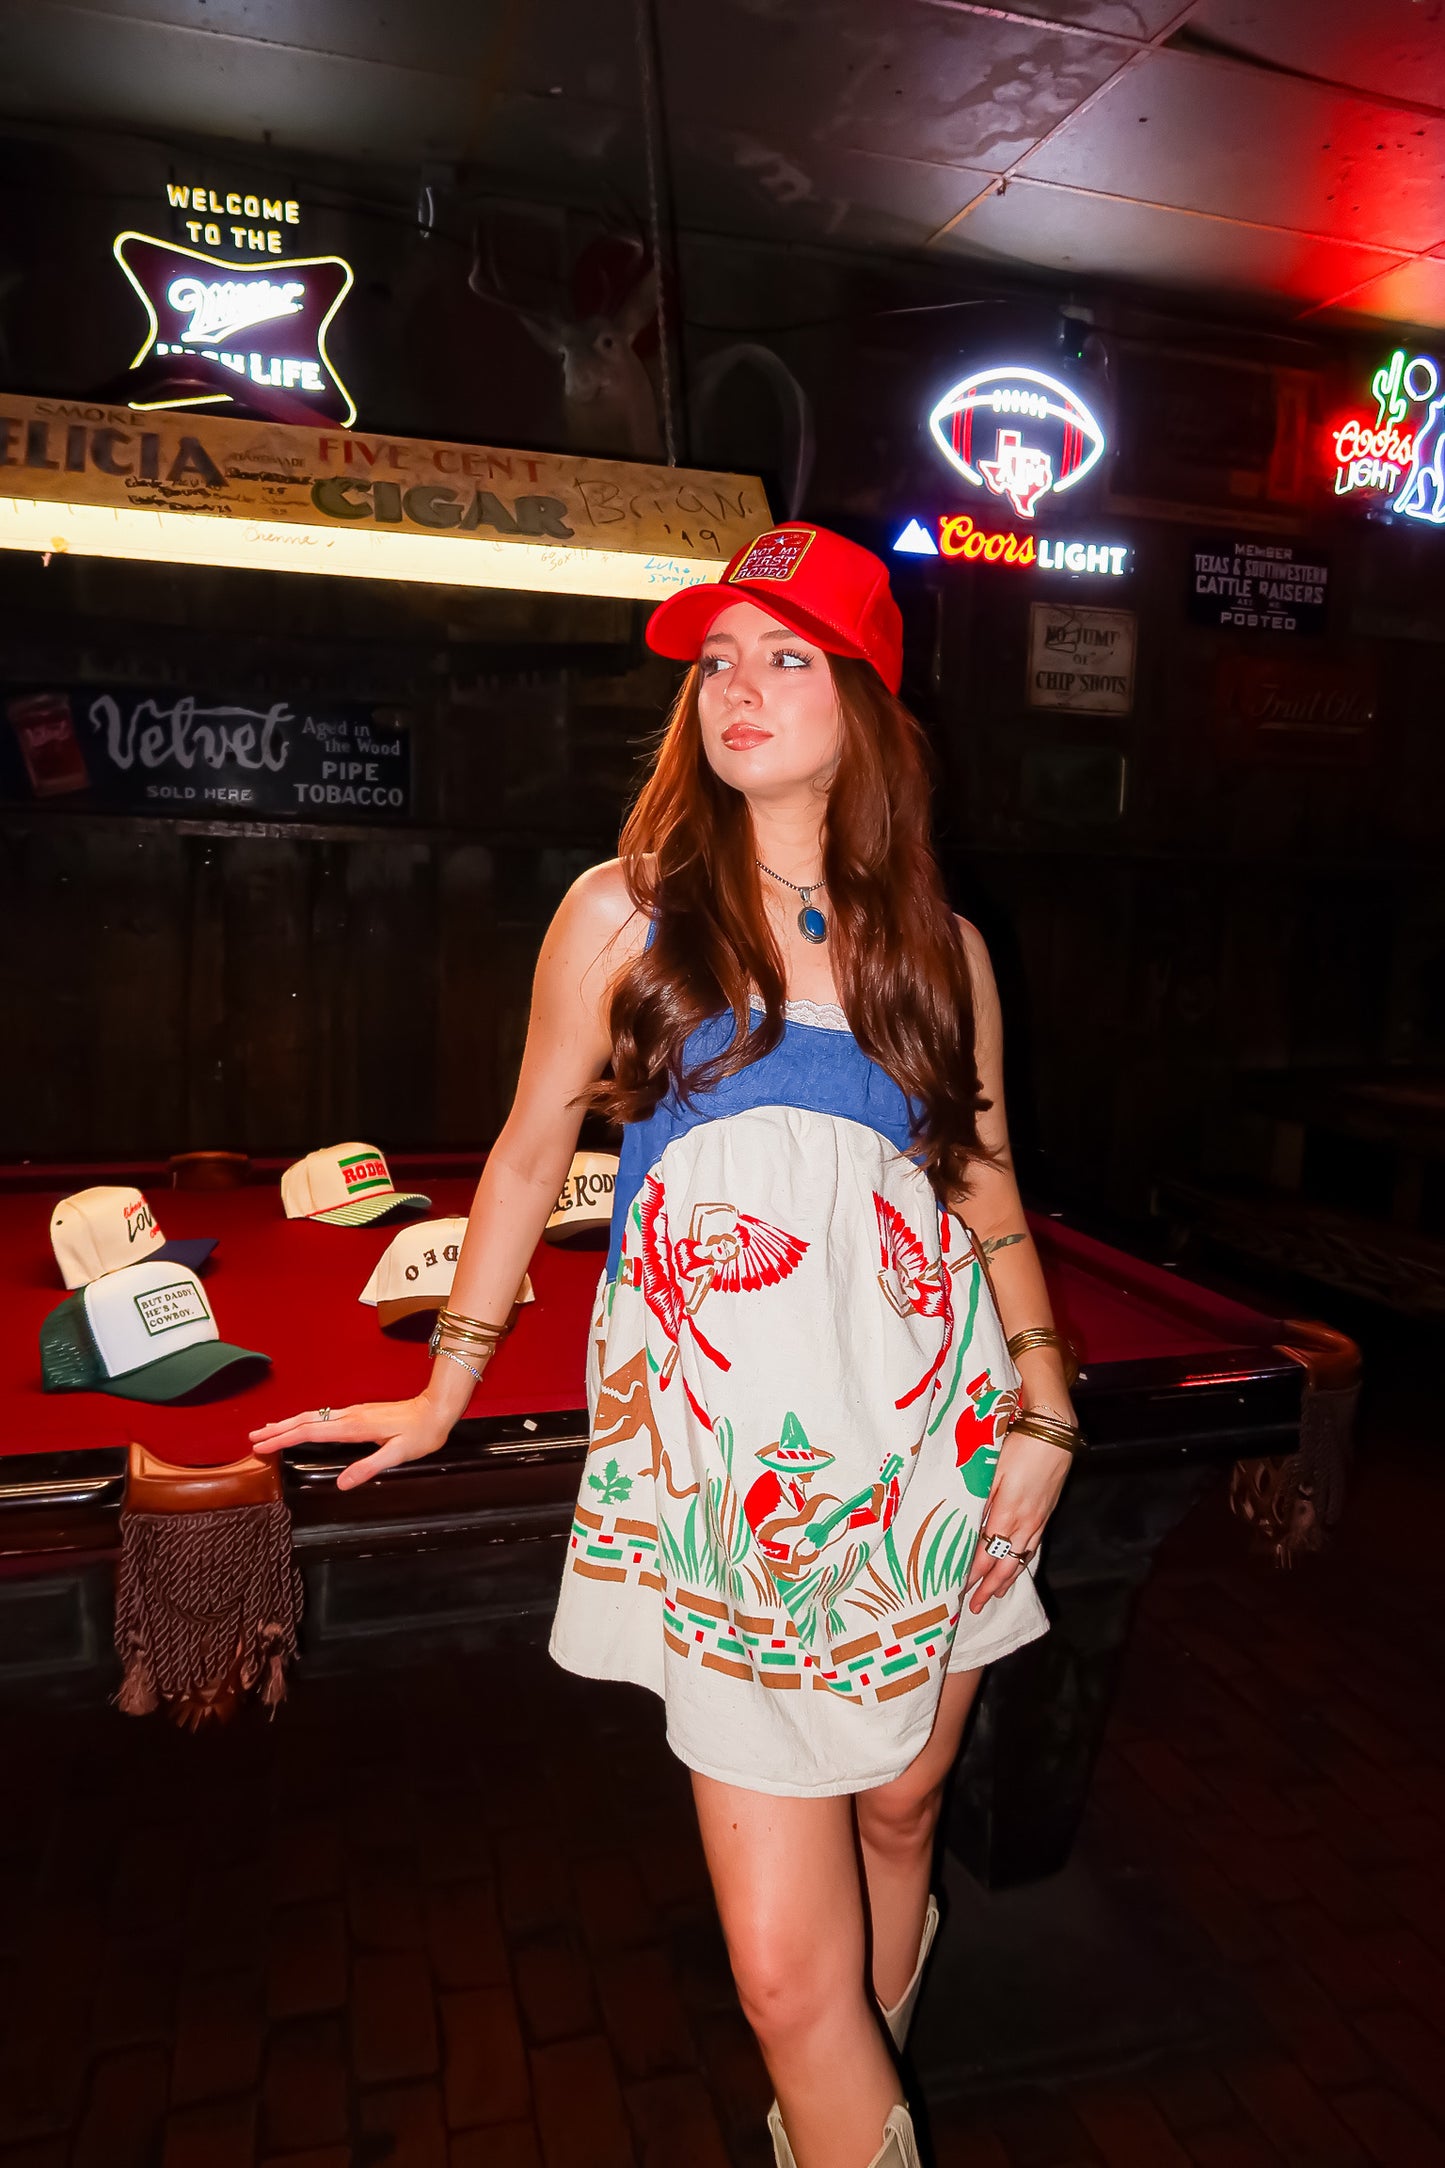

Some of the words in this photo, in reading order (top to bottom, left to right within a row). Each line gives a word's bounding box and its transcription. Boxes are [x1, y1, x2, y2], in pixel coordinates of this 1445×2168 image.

[167, 184, 299, 224] WELCOME
[186, 221, 220, 245] TO
[231, 227, 281, 253] THE
[249, 353, 325, 390] LIFE
[35, 403, 146, 426] SMOKE
[1332, 420, 1413, 465] Coors
[318, 437, 411, 470] FIVE
[432, 449, 546, 483] CENT
[1334, 457, 1402, 495] LIGHT
[311, 476, 576, 538] CIGAR
[750, 547, 775, 557] NOT
[779, 547, 801, 555] MY
[940, 515, 1037, 565] Coors
[1038, 539, 1128, 575] LIGHT
[1235, 543, 1293, 560] MEMBER
[735, 566, 788, 579] RODEO
[742, 555, 796, 568] FIRST
[1194, 553, 1230, 575] TEXAS
[1233, 558, 1242, 576] &
[1195, 575, 1252, 597] CATTLE
[1258, 581, 1324, 604] RAISERS
[1220, 611, 1297, 630] POSTED
[1036, 670, 1075, 691] CHIP
[1079, 674, 1127, 696] SHOTS
[89, 694, 296, 772] Velvet
[302, 716, 347, 740] Aged
[354, 721, 370, 736] in
[325, 738, 351, 753] the
[357, 738, 400, 756] Wood
[322, 761, 379, 781] PIPE
[146, 784, 196, 799] SOLD
[204, 788, 253, 801] HERE
[292, 783, 404, 807] TOBACCO
[573, 1174, 617, 1208] ROD
[141, 1296, 162, 1310] BUT
[145, 1304, 169, 1318] HE'S
[172, 1302, 179, 1310] A
[149, 1308, 195, 1328] COWBOY.
